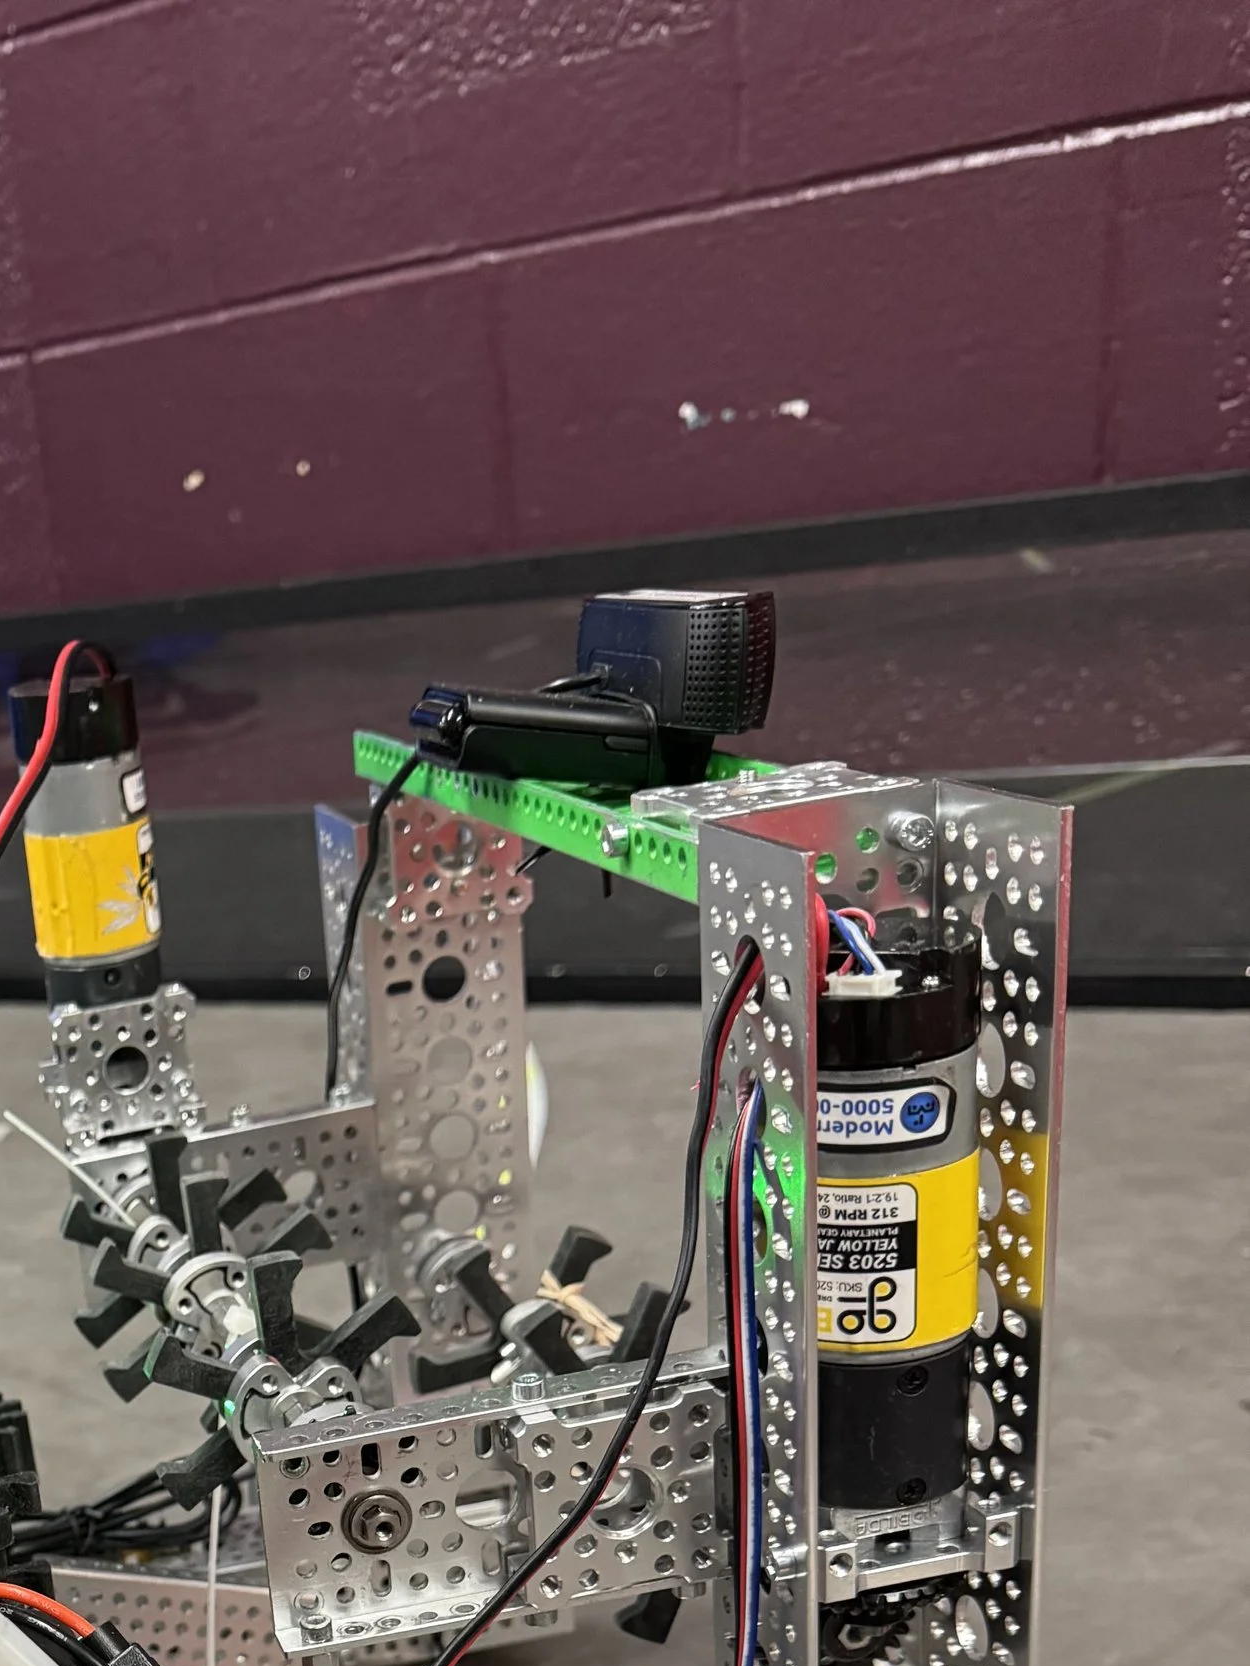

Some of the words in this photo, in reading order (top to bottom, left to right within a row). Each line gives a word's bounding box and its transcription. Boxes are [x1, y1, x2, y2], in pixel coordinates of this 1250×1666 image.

[816, 1098, 895, 1116] 5000-0
[832, 1193, 862, 1204] Ratio,
[866, 1192, 899, 1204] 19.2:1
[818, 1205, 831, 1219] @
[835, 1209, 868, 1221] RPM
[871, 1207, 899, 1220] 312
[840, 1226, 899, 1238] PLANETARY
[837, 1238, 898, 1252] YELLOW
[848, 1252, 898, 1269] 5203
[836, 1281, 863, 1292] SKU:
